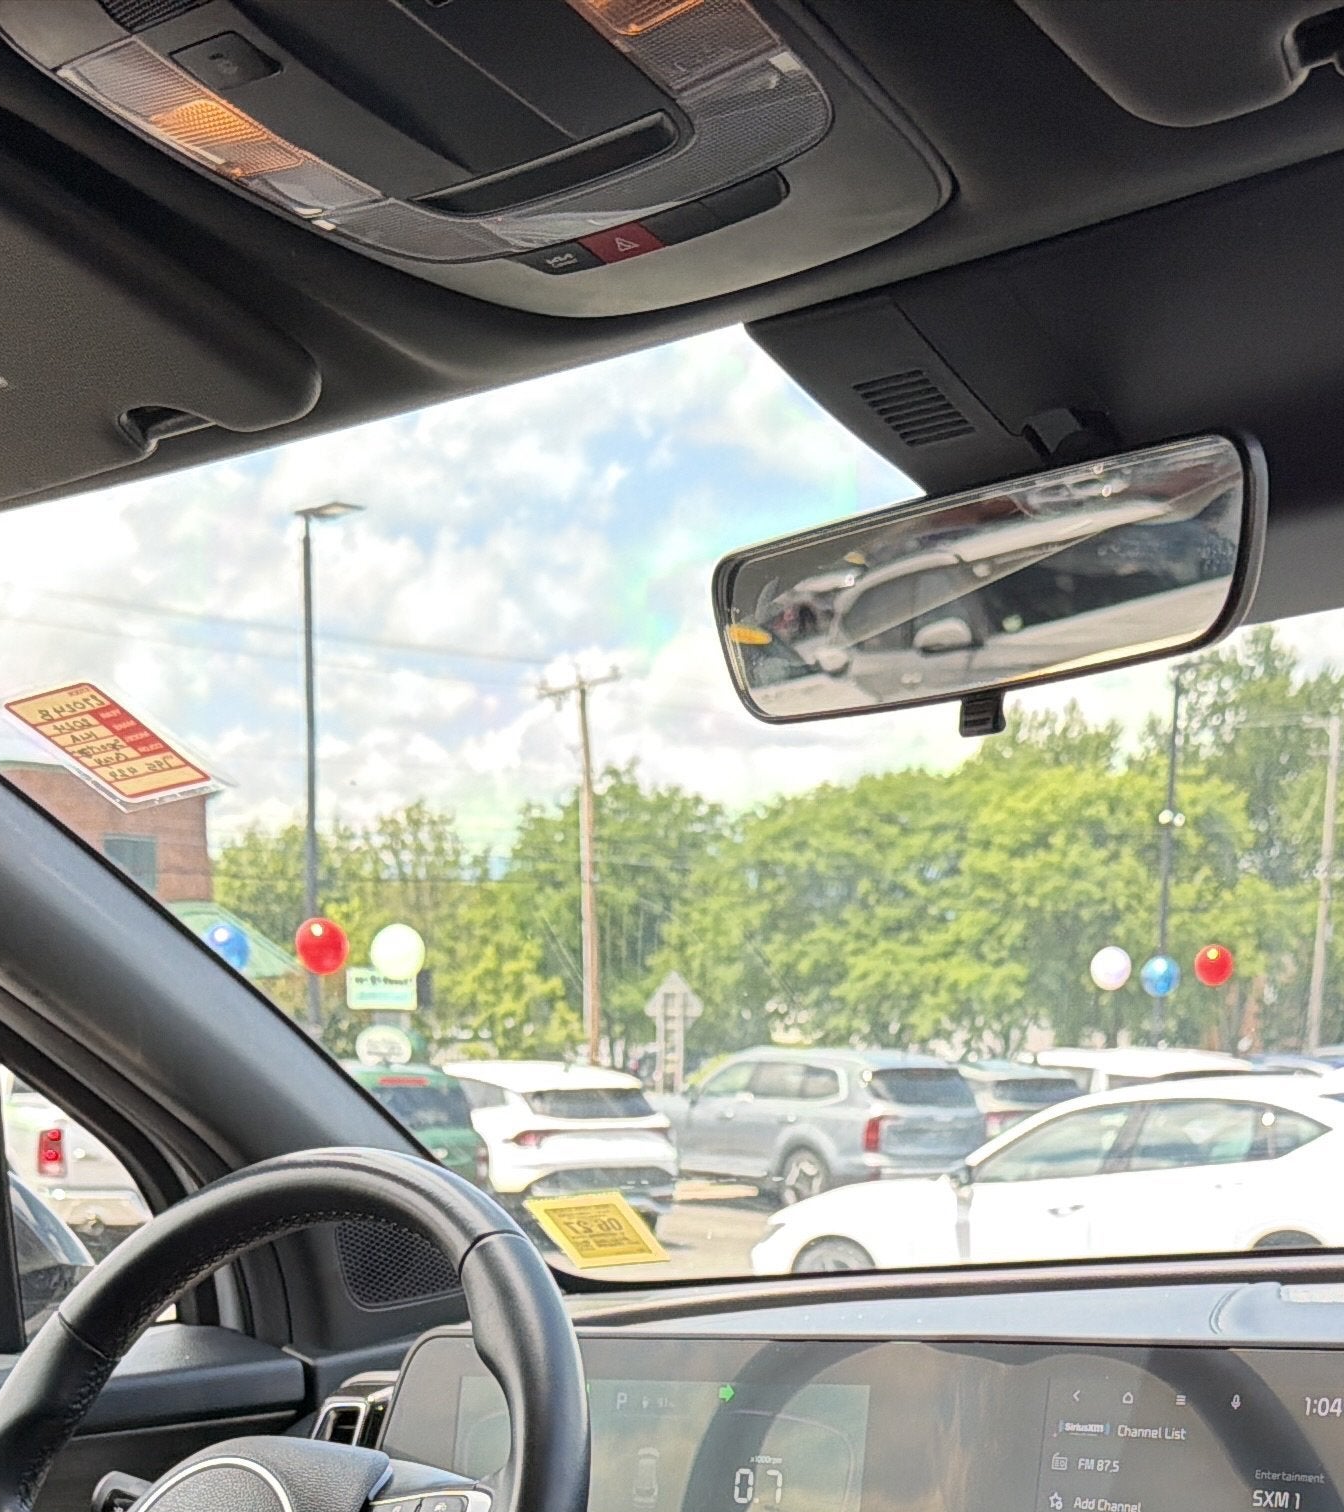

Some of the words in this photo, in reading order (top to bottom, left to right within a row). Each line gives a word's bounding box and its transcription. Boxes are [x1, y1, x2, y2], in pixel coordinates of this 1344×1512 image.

[1305, 1396, 1342, 1418] 1:04
[1117, 1424, 1162, 1440] Channel
[1164, 1427, 1187, 1441] List
[1077, 1457, 1095, 1471] FM
[1255, 1469, 1325, 1484] Entertainment
[733, 1467, 783, 1505] 0.7
[1073, 1496, 1096, 1510] Add
[1252, 1489, 1288, 1509] SXM
[1294, 1492, 1301, 1510] 1
